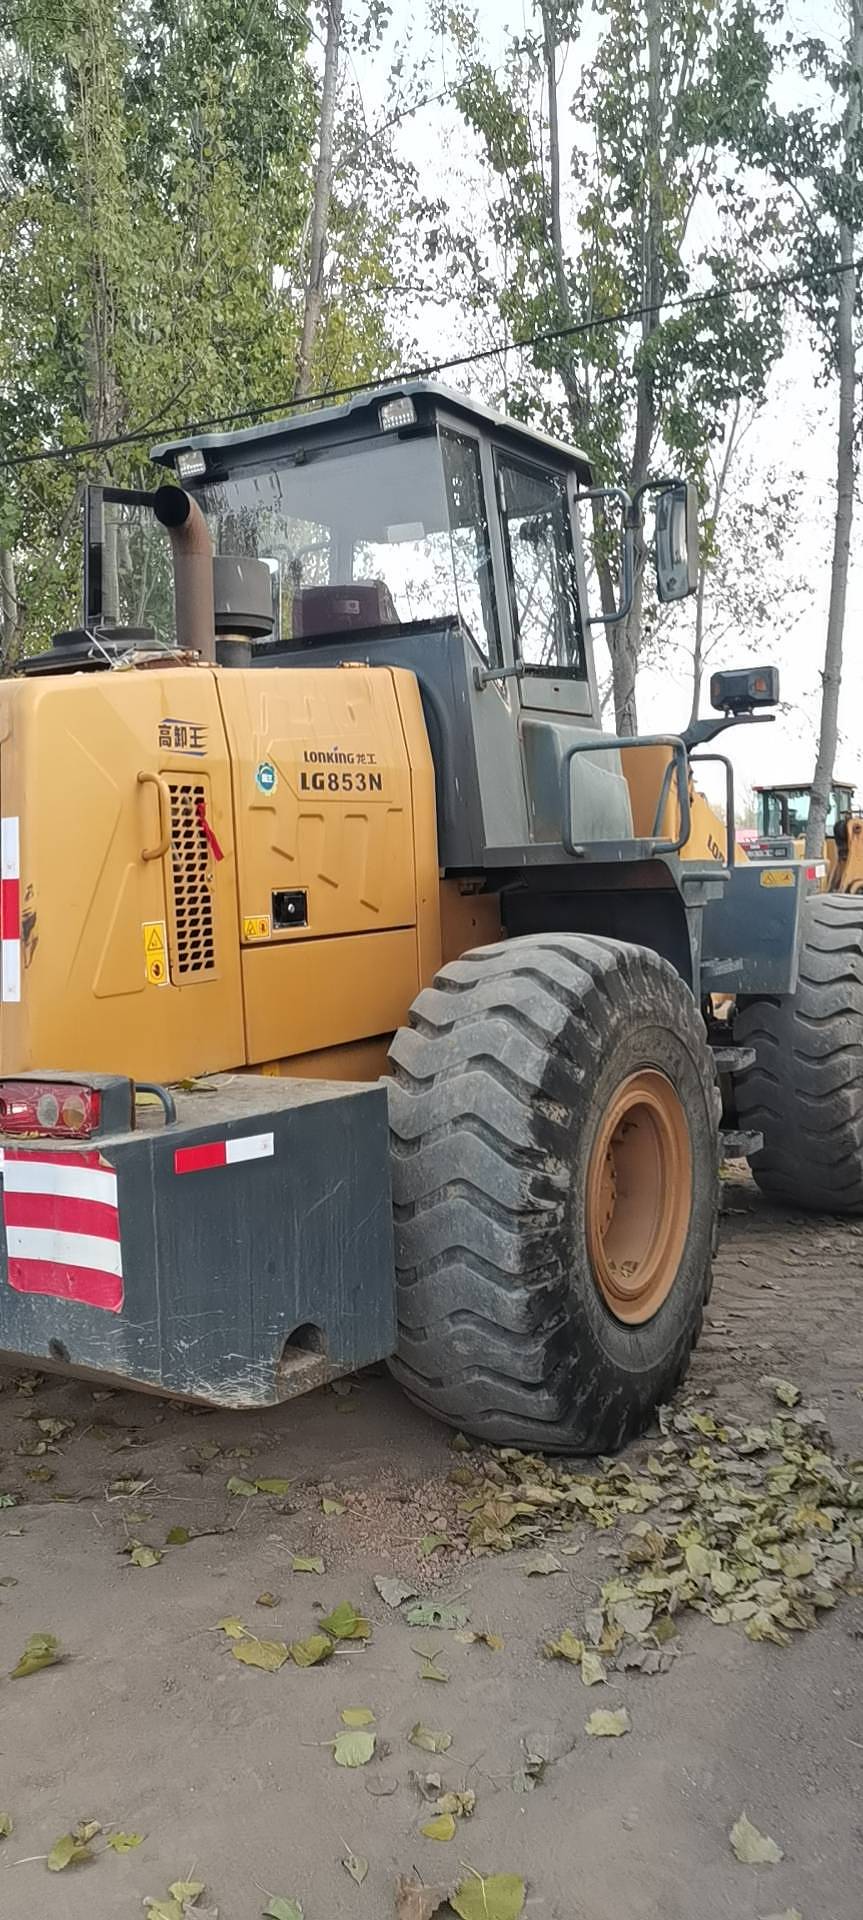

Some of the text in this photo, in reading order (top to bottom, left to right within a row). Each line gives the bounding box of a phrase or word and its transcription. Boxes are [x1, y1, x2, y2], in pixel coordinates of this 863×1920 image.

[158, 724, 208, 748] 高卸王
[355, 753, 377, 764] 龙工
[300, 772, 382, 791] LG853N
